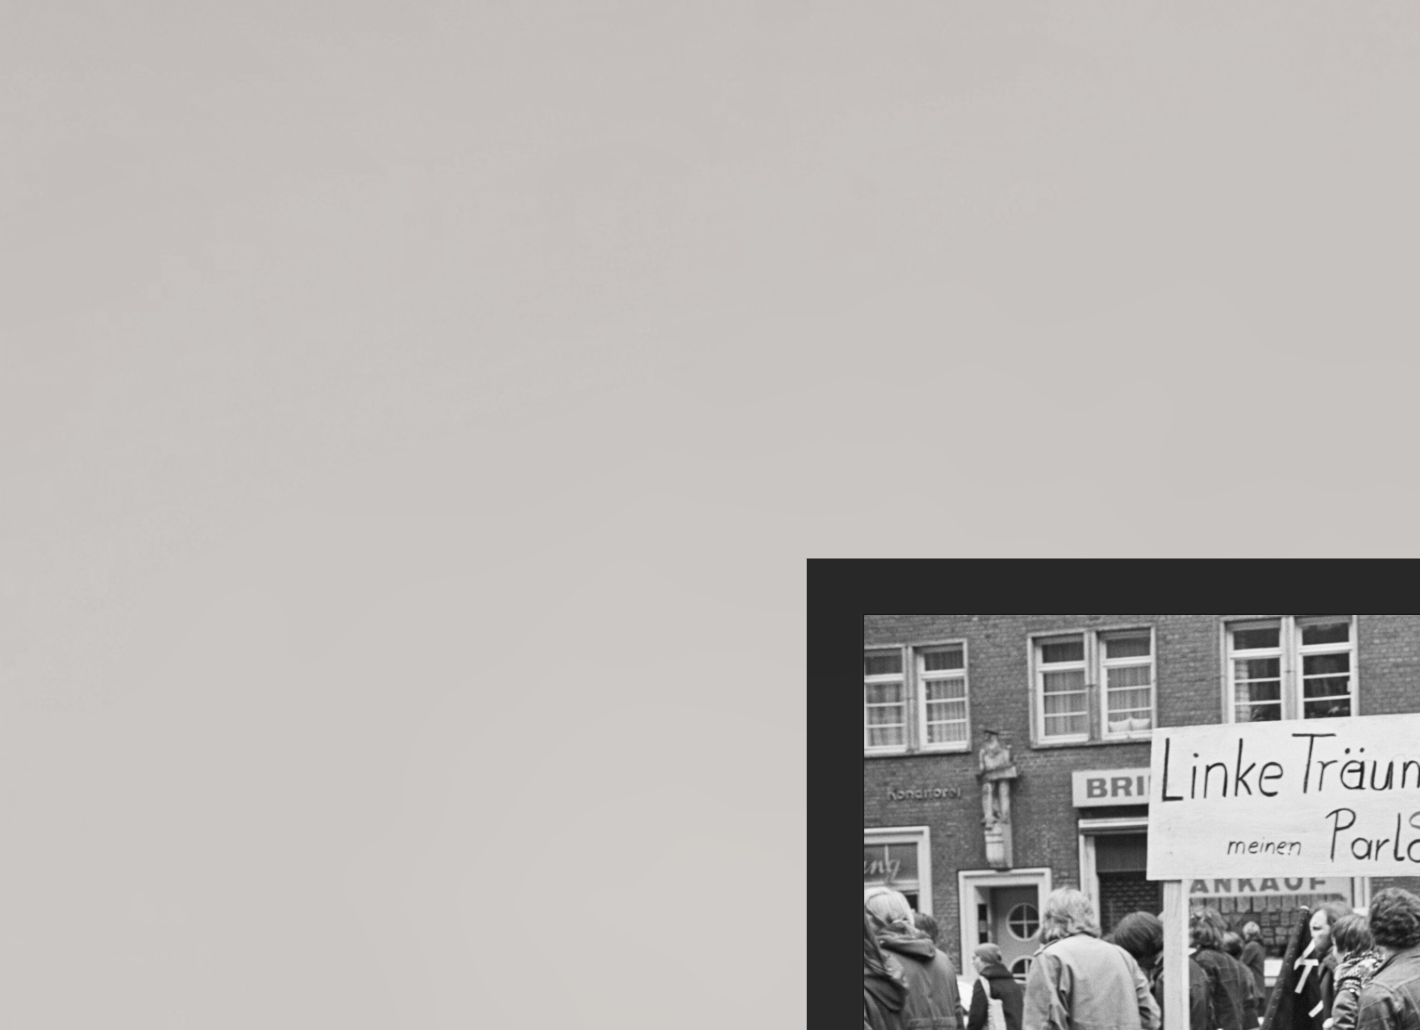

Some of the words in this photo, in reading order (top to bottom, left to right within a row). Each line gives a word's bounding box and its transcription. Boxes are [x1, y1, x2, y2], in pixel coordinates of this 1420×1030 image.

[1161, 736, 1285, 802] Linke
[1086, 775, 1151, 799] BRI
[1227, 838, 1302, 856] meinen
